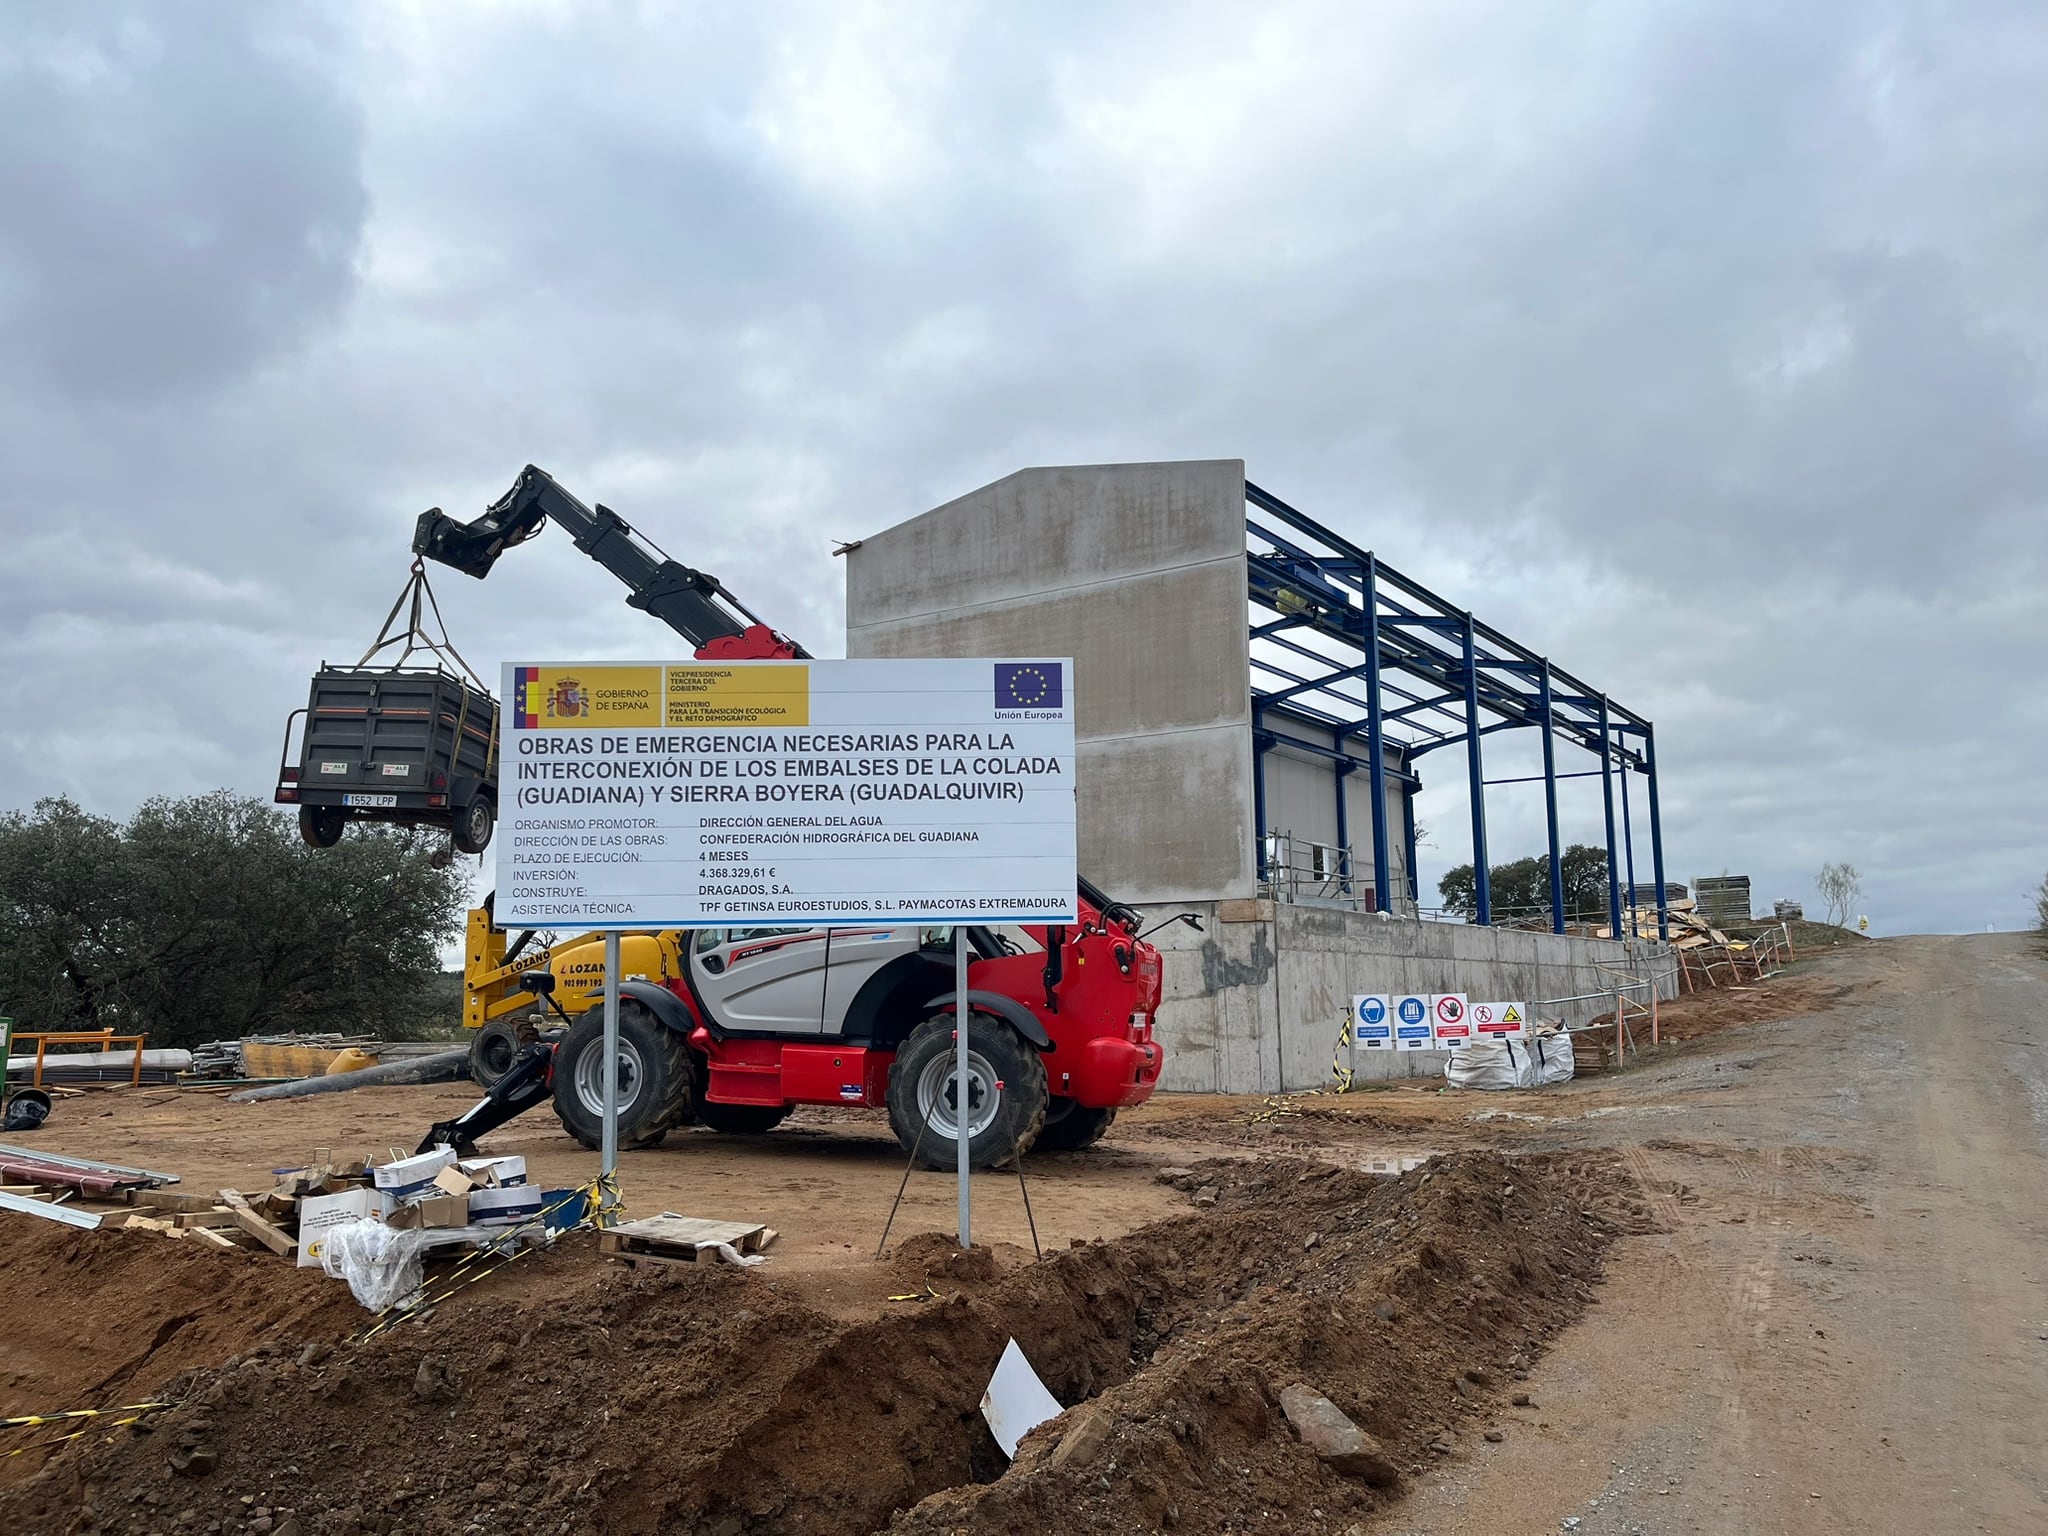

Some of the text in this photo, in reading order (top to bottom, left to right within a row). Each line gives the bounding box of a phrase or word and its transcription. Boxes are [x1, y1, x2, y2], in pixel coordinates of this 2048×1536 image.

[596, 690, 649, 698] GOBIERNO
[596, 700, 650, 710] DE ESPAÑA
[700, 707, 744, 715] TRANSICIÓN
[745, 706, 787, 714] ECOLÓGICA
[994, 711, 1063, 720] Unión Europea
[518, 733, 1015, 755] OBRAS DE EMERGENCIA NECESARIAS PARA LA
[518, 757, 1061, 779] INTERCONEXIÓN DE LOS EMBALSES DE LA COLADA
[517, 782, 1024, 808] (GUADIANA) Y SIERRA BOYERA (GUADALQUIVIR)
[351, 796, 394, 806] 1552 LPP
[514, 819, 658, 830] ORGANISMO PROMOTOR:
[700, 816, 883, 828] DIRECCIÓN GENERAL DEL AGUA
[514, 835, 668, 847] DIRECCIÓN DE LAS OBRAS:
[700, 831, 979, 844] CONFEDERACIÓN HIDROGRÁFICA DEL GUADIANA
[513, 851, 642, 864] PLAZO DE EJECUCIÓN:
[699, 851, 749, 861] 4 MESES
[513, 869, 579, 881] INVERSIÓN:
[699, 868, 776, 879] 4.368.329,61 €
[512, 887, 588, 898] CONSTRUYE:
[699, 884, 794, 895] DRAGADOS, S.A.
[511, 902, 636, 915] ASISTENCIA TÉCNICA:
[700, 898, 1067, 912] TPF GETINSA EUROESTUDIOS, S.L. PAYMACOTAS EXTREMADURA
[510, 951, 551, 973] LOZANO
[570, 963, 606, 974] LOZAN
[564, 978, 602, 987] 902 999 192
